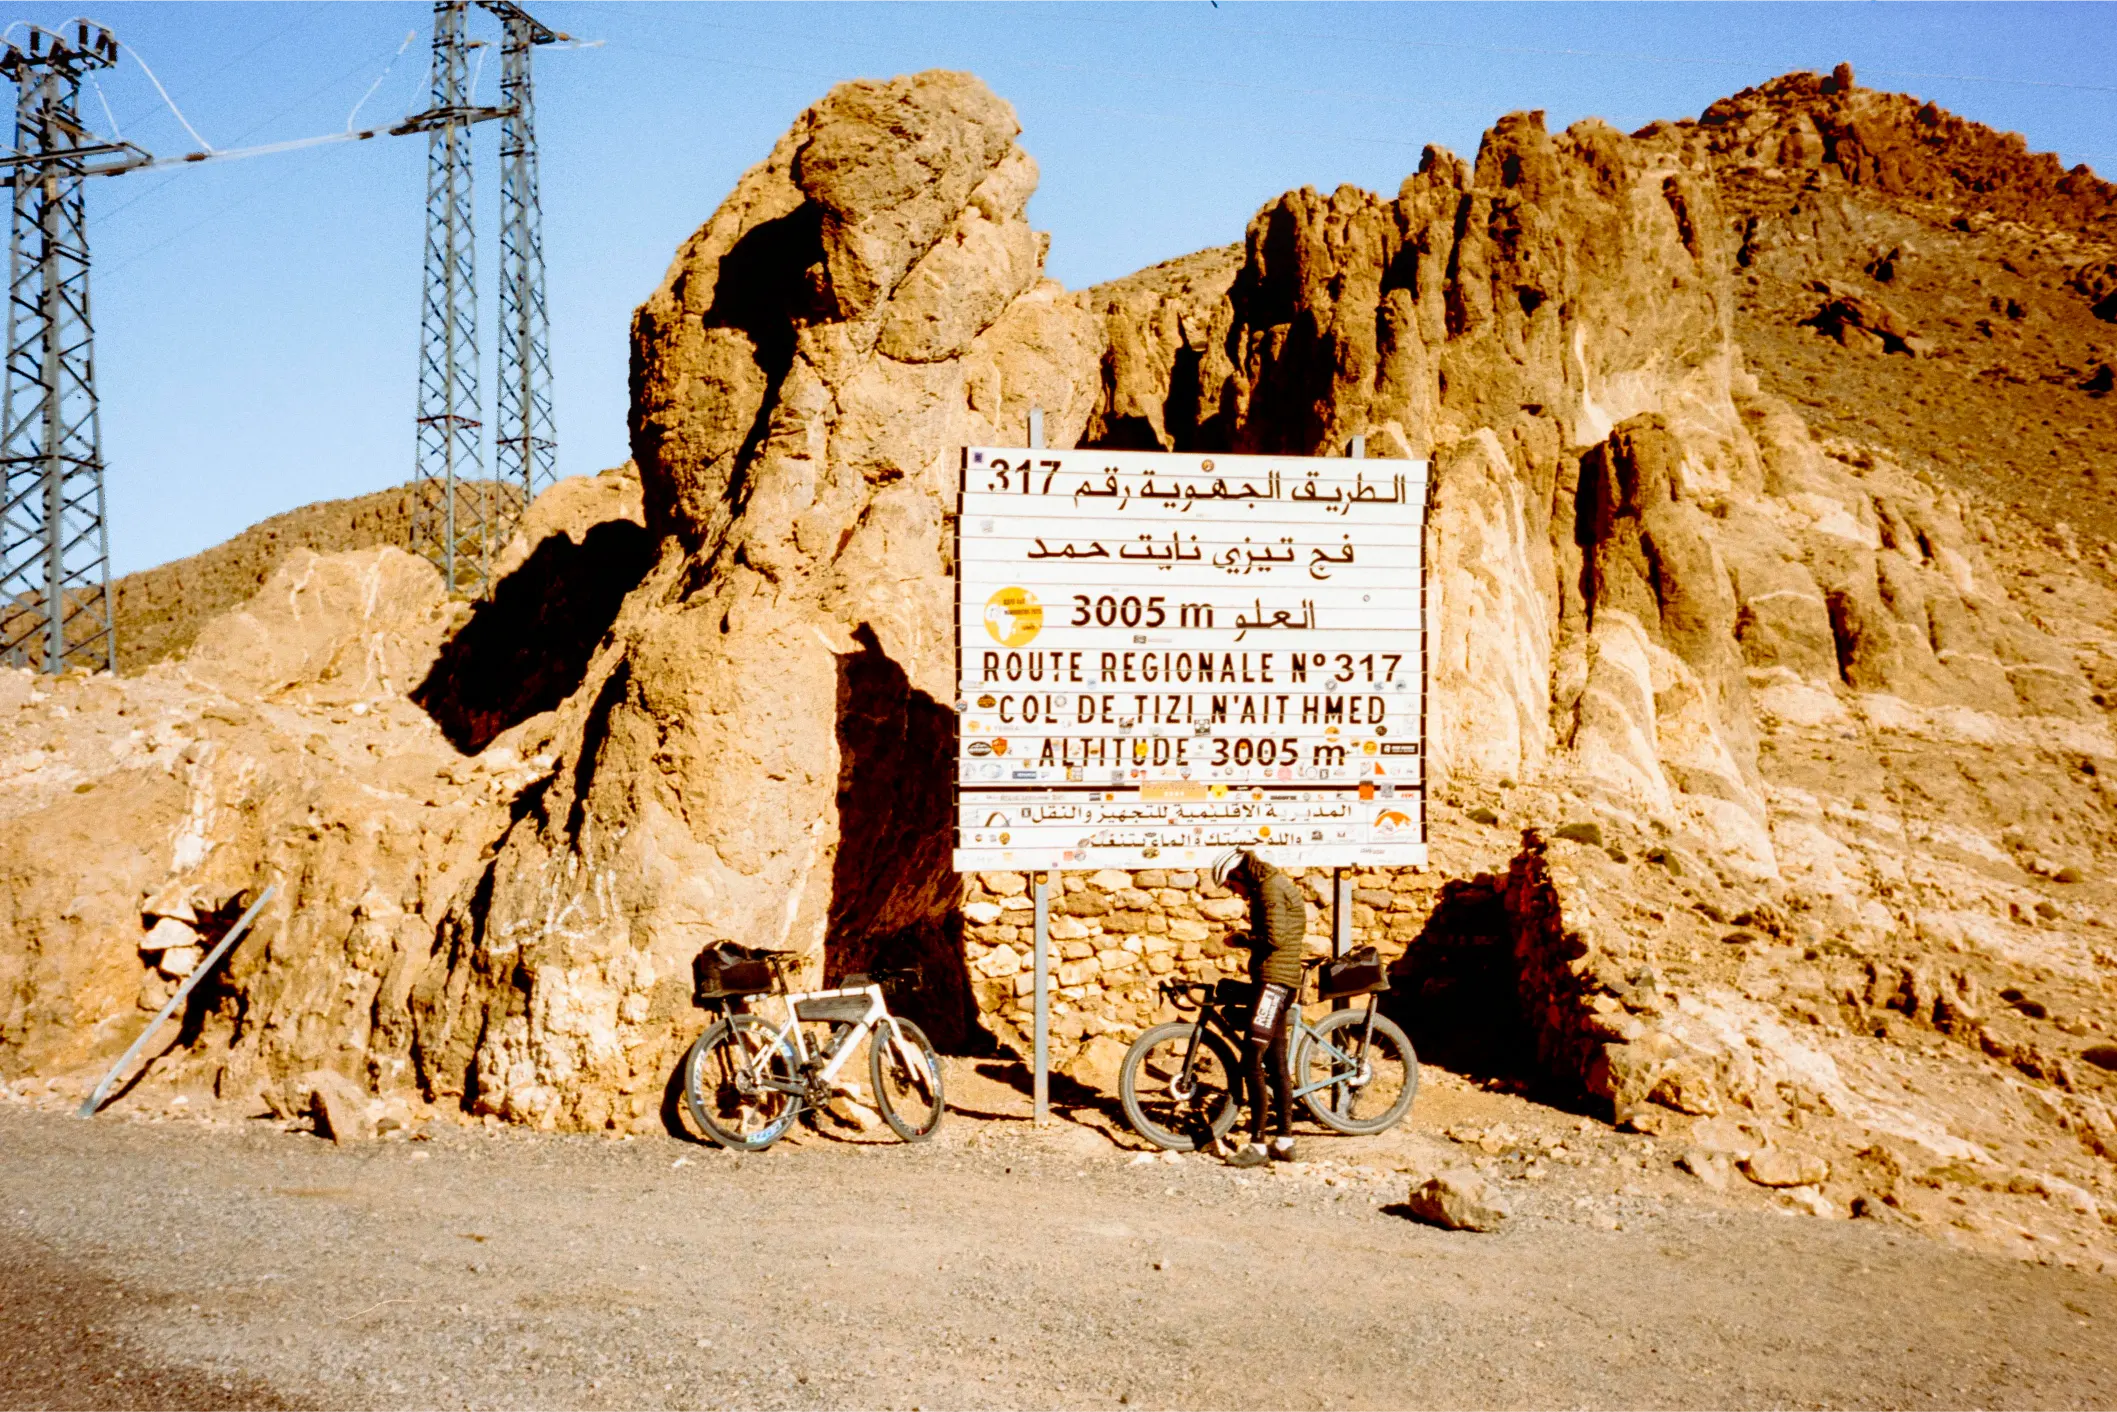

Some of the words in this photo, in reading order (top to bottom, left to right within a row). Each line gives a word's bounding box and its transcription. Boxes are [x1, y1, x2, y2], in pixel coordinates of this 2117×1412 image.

[988, 459, 1061, 495] 317
[1074, 467, 1130, 510] رقم
[1141, 466, 1280, 512] الجهوية
[1292, 472, 1405, 515] الطريق
[1028, 537, 1109, 559] حمد
[1120, 532, 1201, 570] نايت
[1213, 537, 1294, 574] تيزي
[1310, 534, 1353, 580] فج
[1071, 595, 1165, 628] 3005
[1181, 604, 1213, 628] m
[1235, 599, 1315, 641] العلو
[984, 652, 1082, 681] ROUTE
[1102, 653, 1273, 682] REGIONALE
[1000, 695, 1057, 723] COL
[1078, 695, 1114, 723] DE
[1135, 695, 1196, 724] TIZI
[1211, 695, 1289, 723] N'AIT
[1303, 696, 1384, 724] HMED
[1039, 738, 1188, 768] ALTITUDE
[1211, 738, 1298, 766] 3005
[1314, 746, 1345, 766] m
